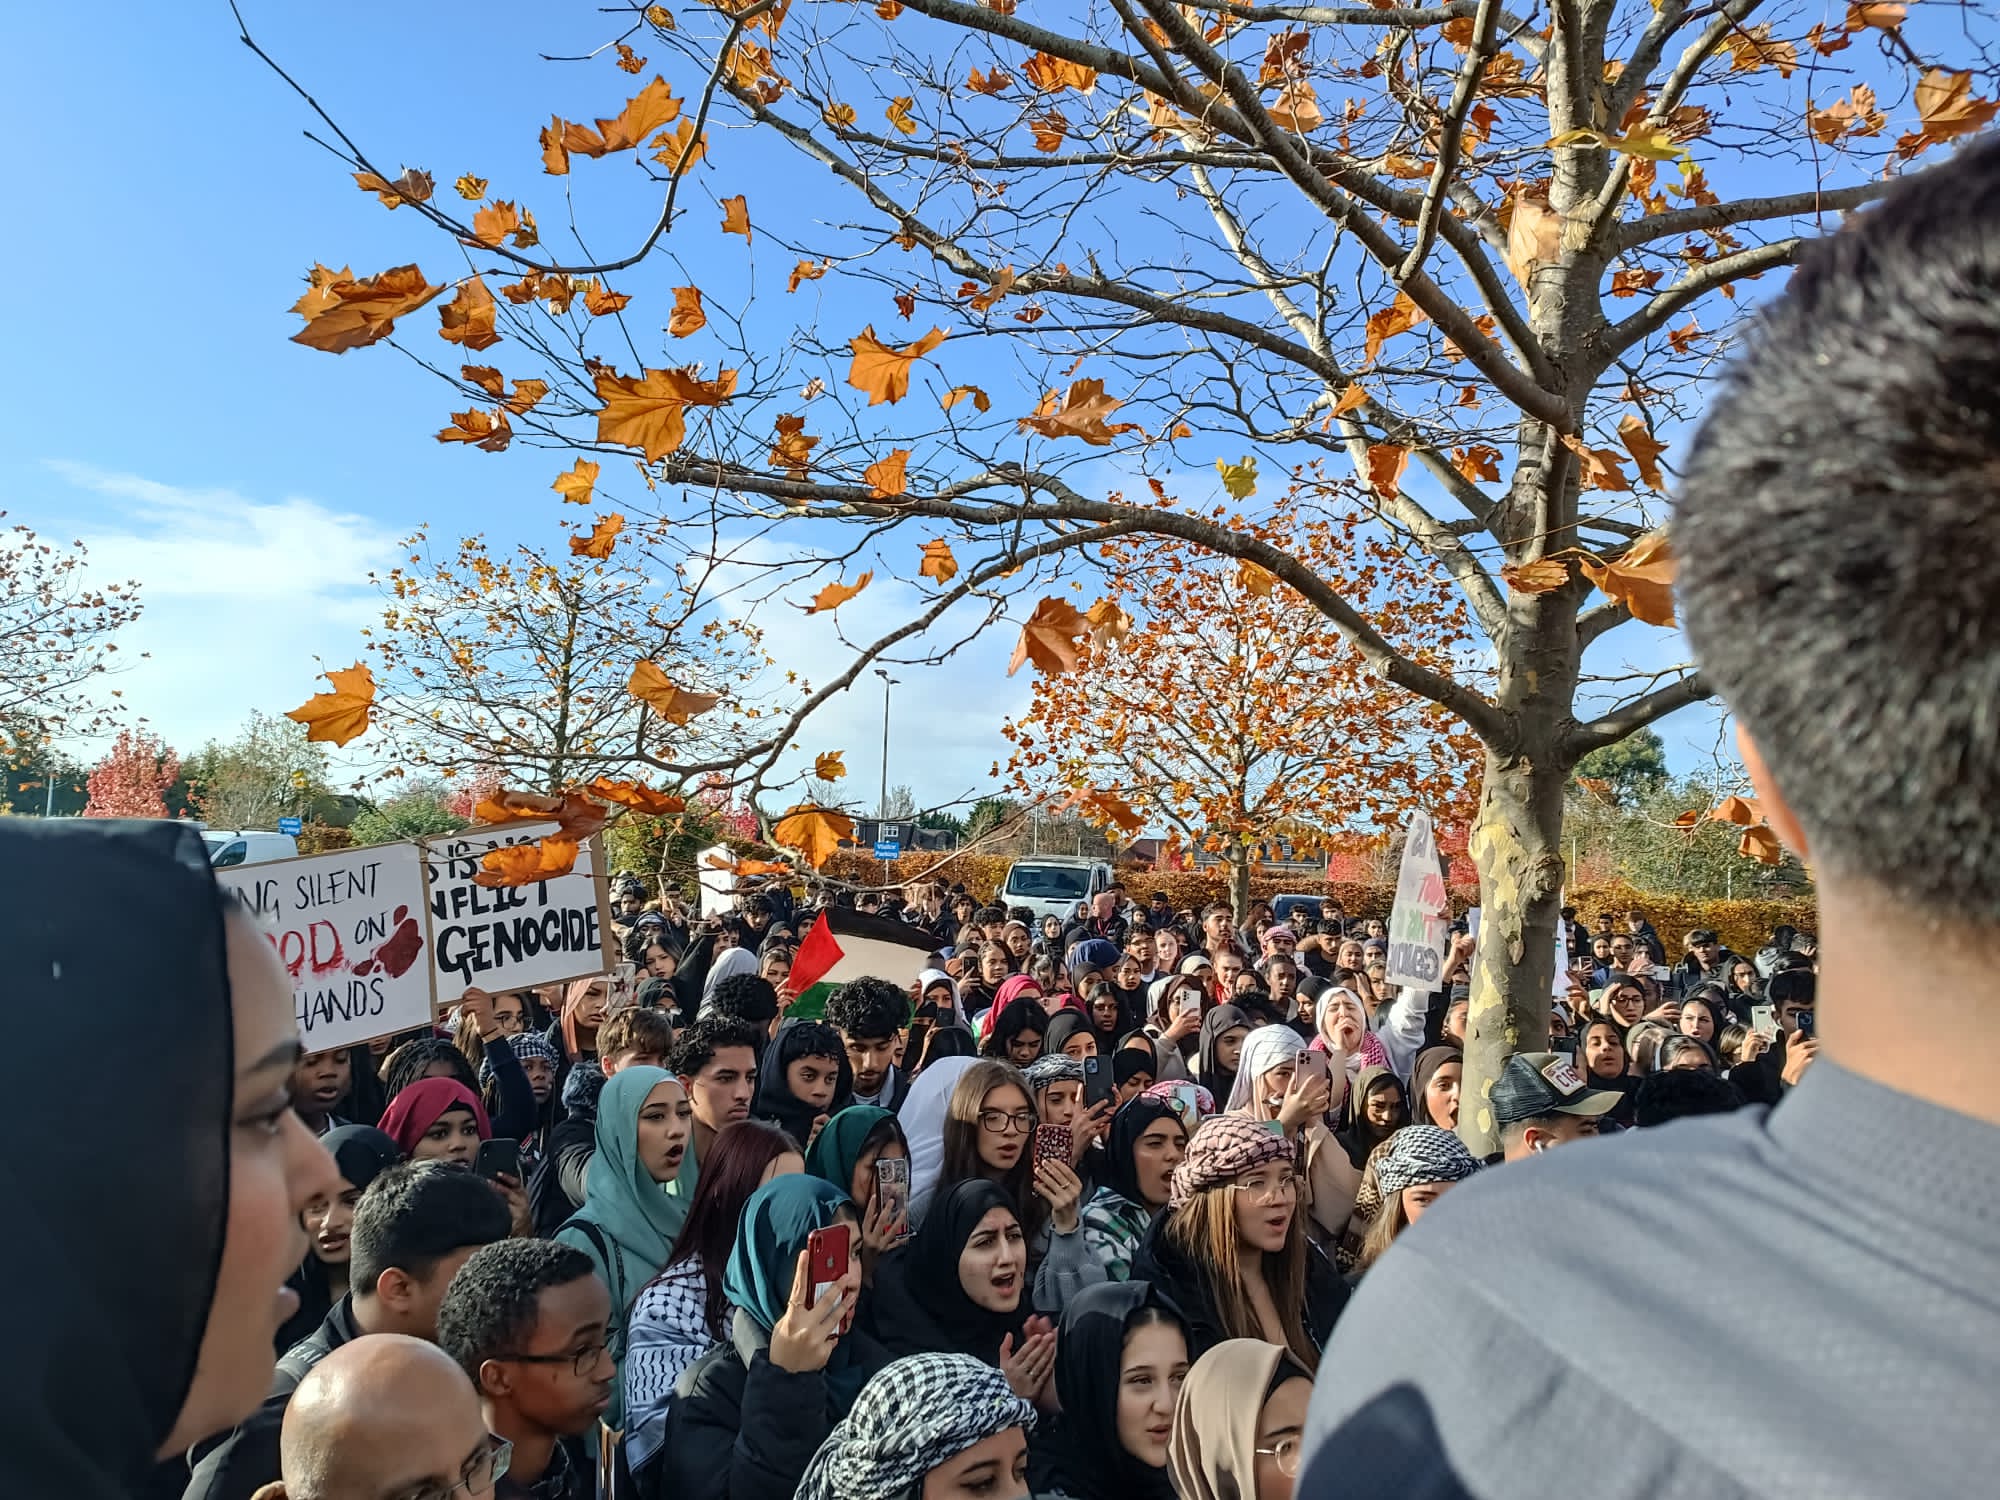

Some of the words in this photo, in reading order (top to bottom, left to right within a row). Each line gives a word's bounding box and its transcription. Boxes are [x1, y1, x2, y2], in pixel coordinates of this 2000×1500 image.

[295, 862, 382, 910] SILENT
[264, 919, 344, 977] OD
[354, 911, 388, 945] ON
[436, 906, 602, 985] GENOCIDE
